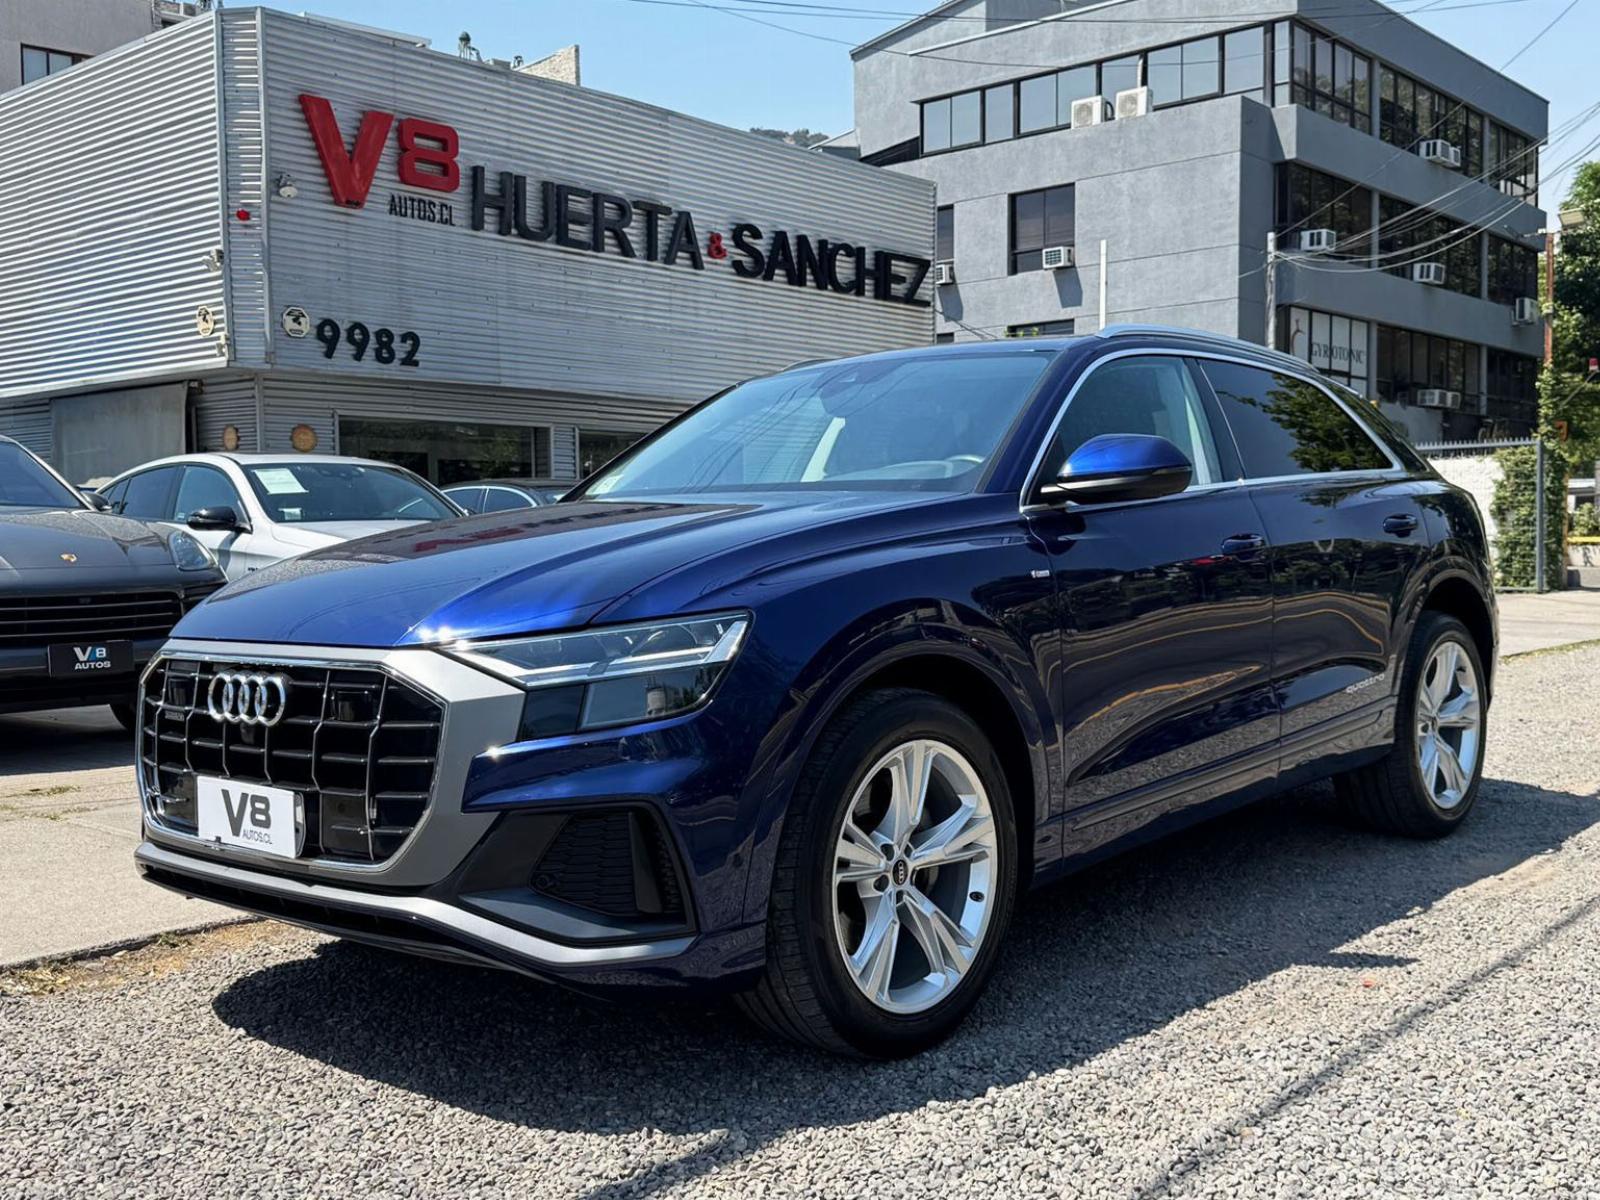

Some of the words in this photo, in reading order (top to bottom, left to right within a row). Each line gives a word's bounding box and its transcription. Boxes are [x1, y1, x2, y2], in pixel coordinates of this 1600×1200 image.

[299, 93, 460, 210] V8
[389, 194, 456, 227] AUTOS.CL
[471, 165, 704, 271] HUERTA
[707, 231, 727, 260] &
[731, 222, 931, 307] SANCHEZ
[316, 318, 420, 367] 9982
[73, 646, 107, 661] V8
[74, 661, 111, 670] AUTOS
[221, 789, 271, 837] V8
